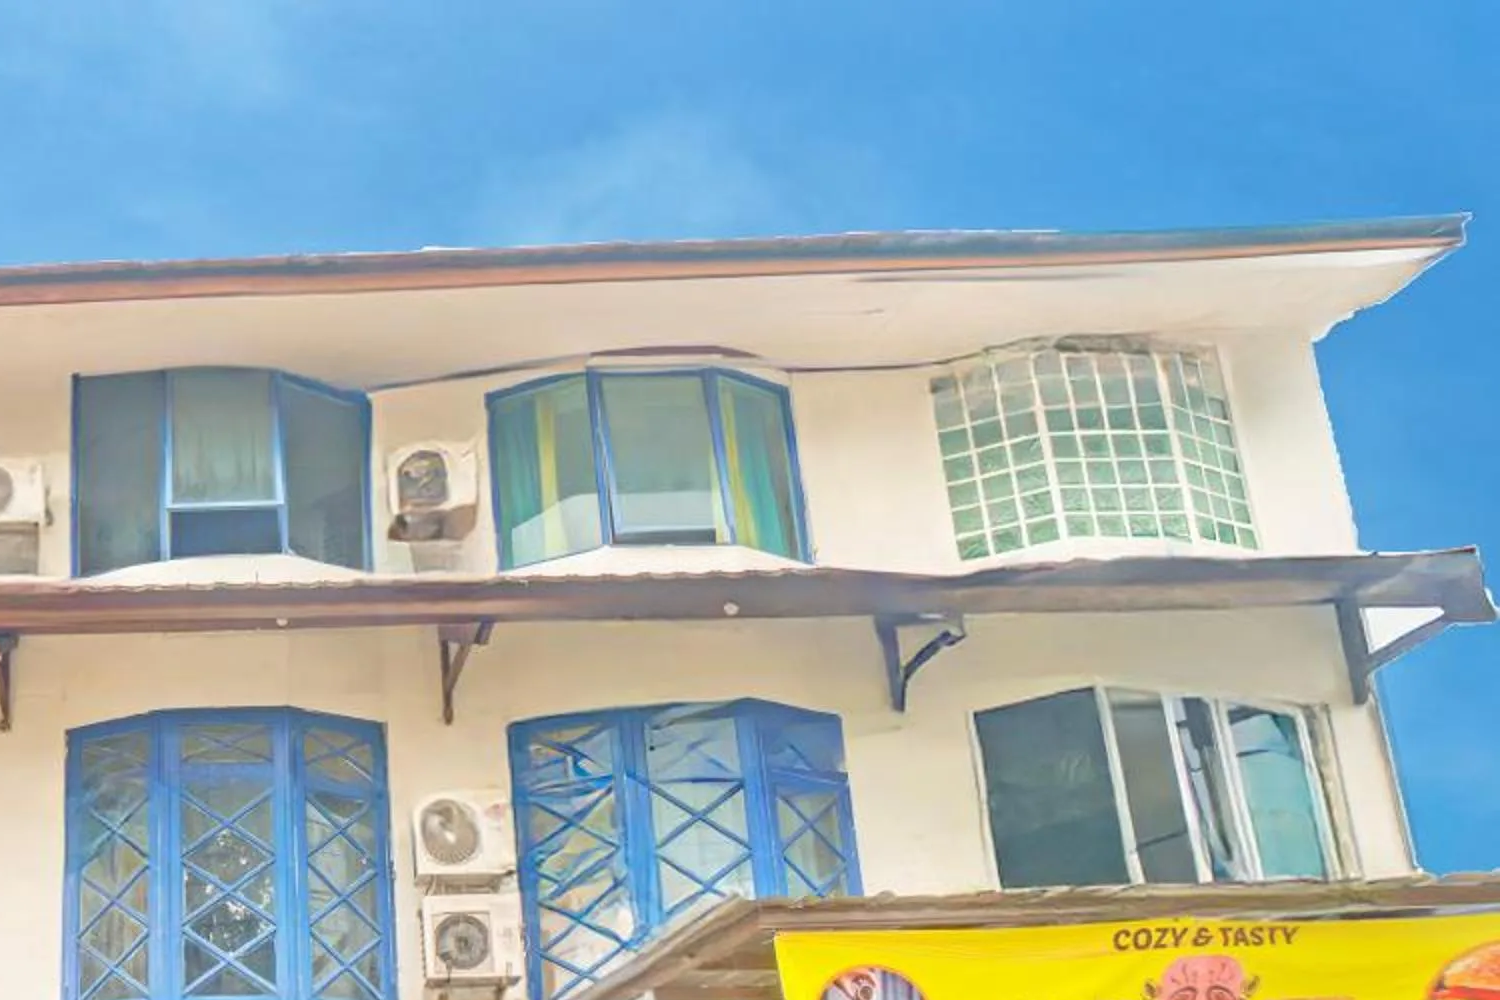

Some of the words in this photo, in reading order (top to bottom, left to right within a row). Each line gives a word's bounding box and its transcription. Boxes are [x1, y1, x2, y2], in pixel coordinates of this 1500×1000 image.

[1113, 927, 1188, 951] COZY
[1192, 927, 1212, 946] &
[1219, 926, 1299, 946] TASTY
